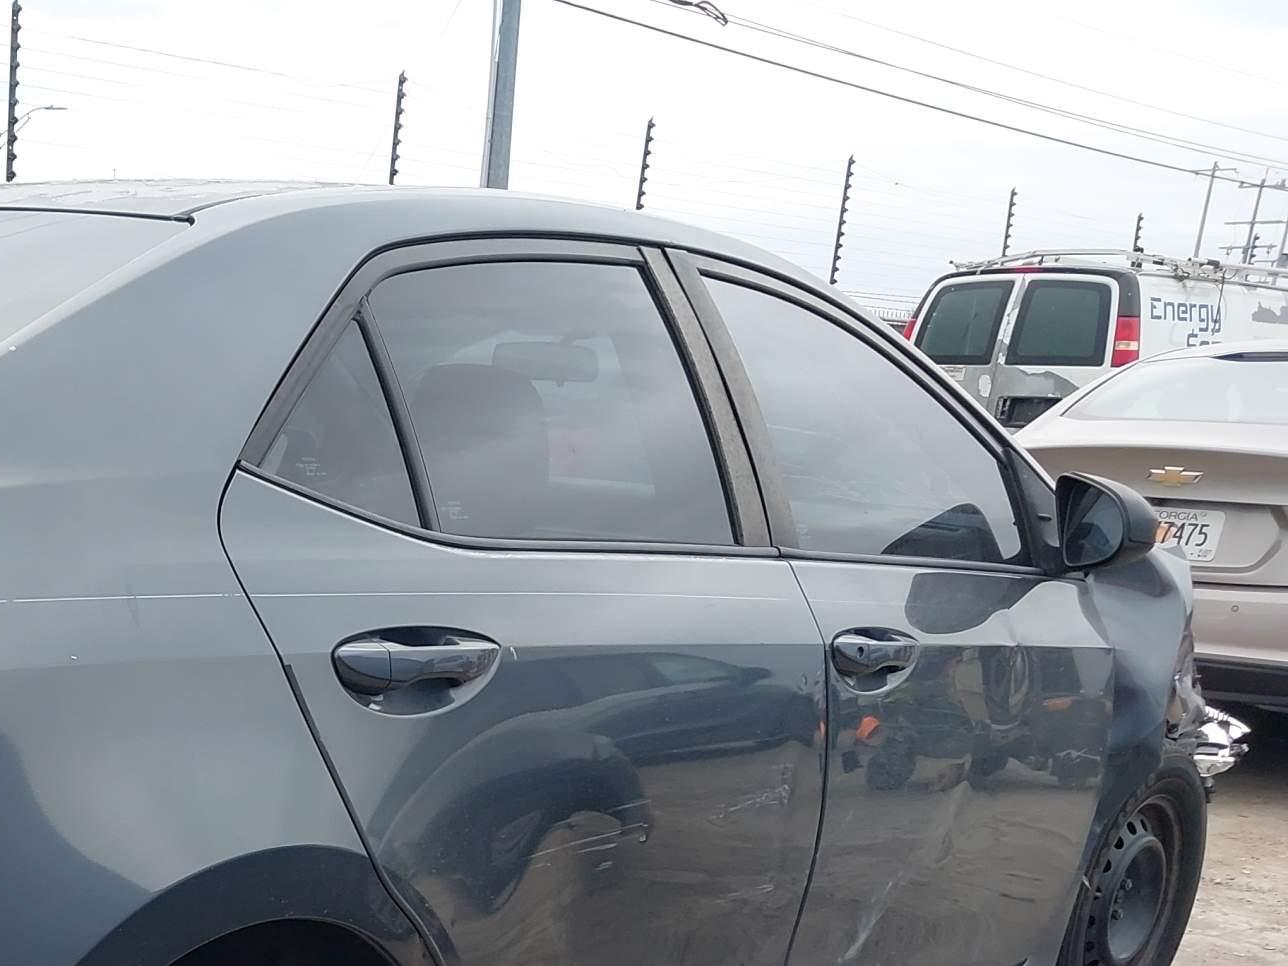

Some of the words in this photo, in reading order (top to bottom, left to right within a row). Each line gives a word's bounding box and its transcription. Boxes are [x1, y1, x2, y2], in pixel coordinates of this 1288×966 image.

[1150, 297, 1222, 333] Energy
[1153, 510, 1199, 521] ORGIA
[1158, 520, 1210, 547] 7475
